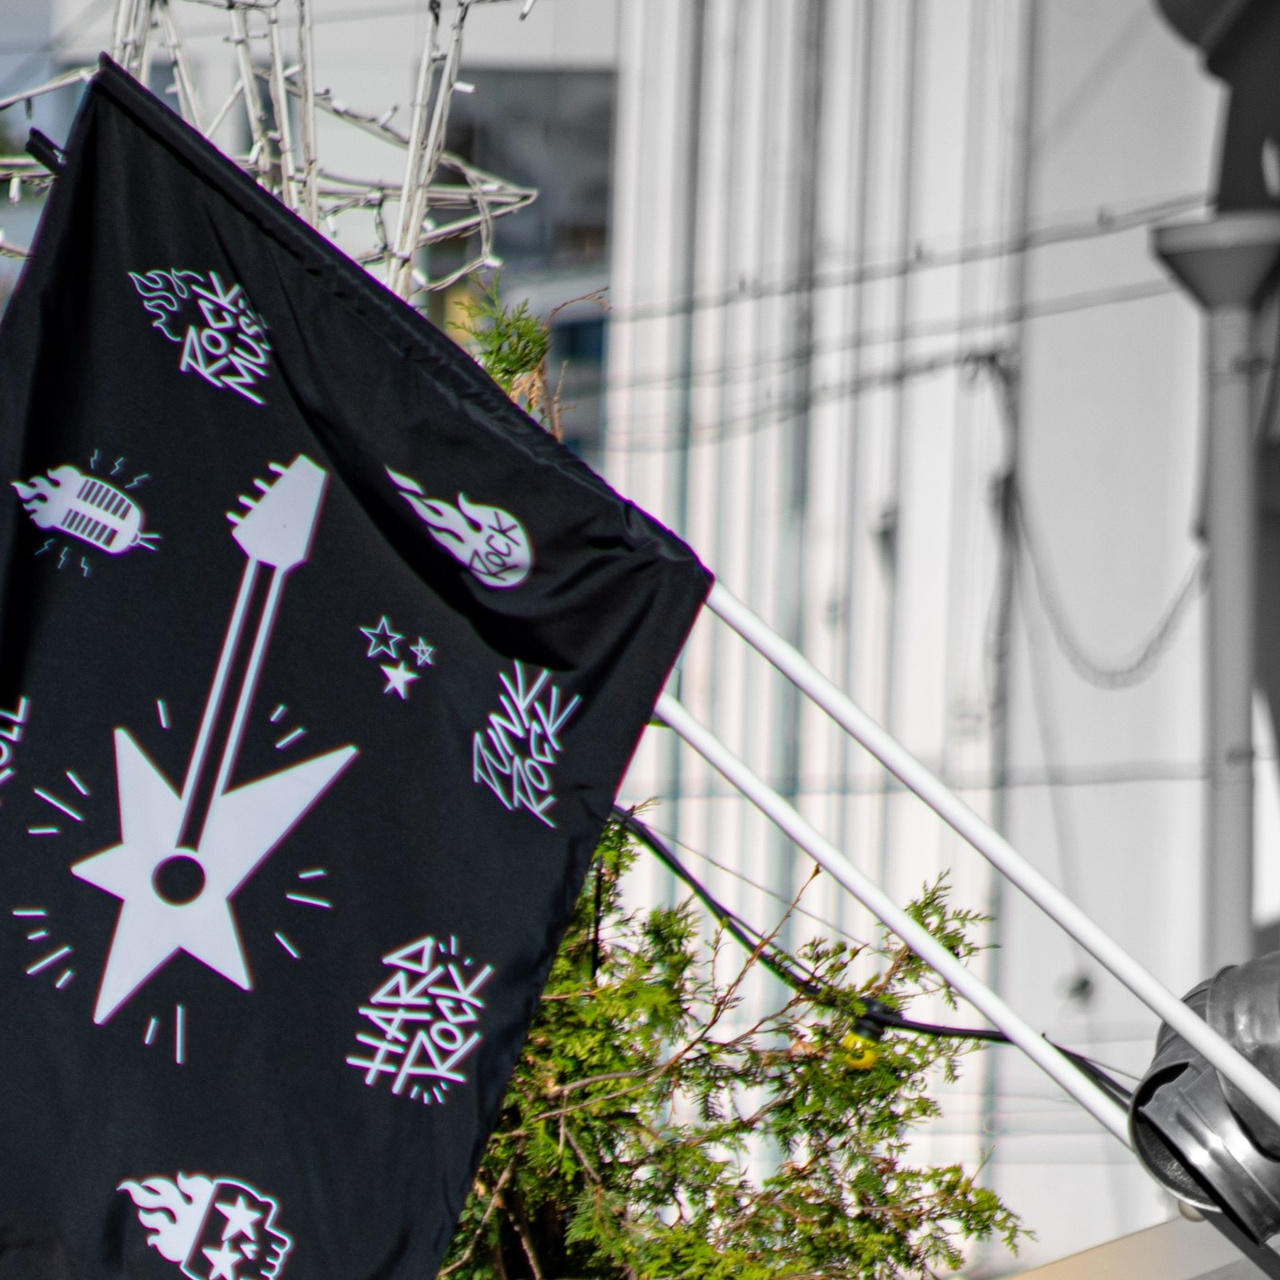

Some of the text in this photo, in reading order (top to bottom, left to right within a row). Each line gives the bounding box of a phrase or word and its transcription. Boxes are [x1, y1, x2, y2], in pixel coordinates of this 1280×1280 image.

[179, 270, 242, 388] ROCK
[468, 510, 521, 582] ROCK
[472, 658, 551, 811] PUNK
[513, 684, 582, 829] ROCK
[345, 935, 446, 1087] HARD
[391, 963, 494, 1095] ROCK
